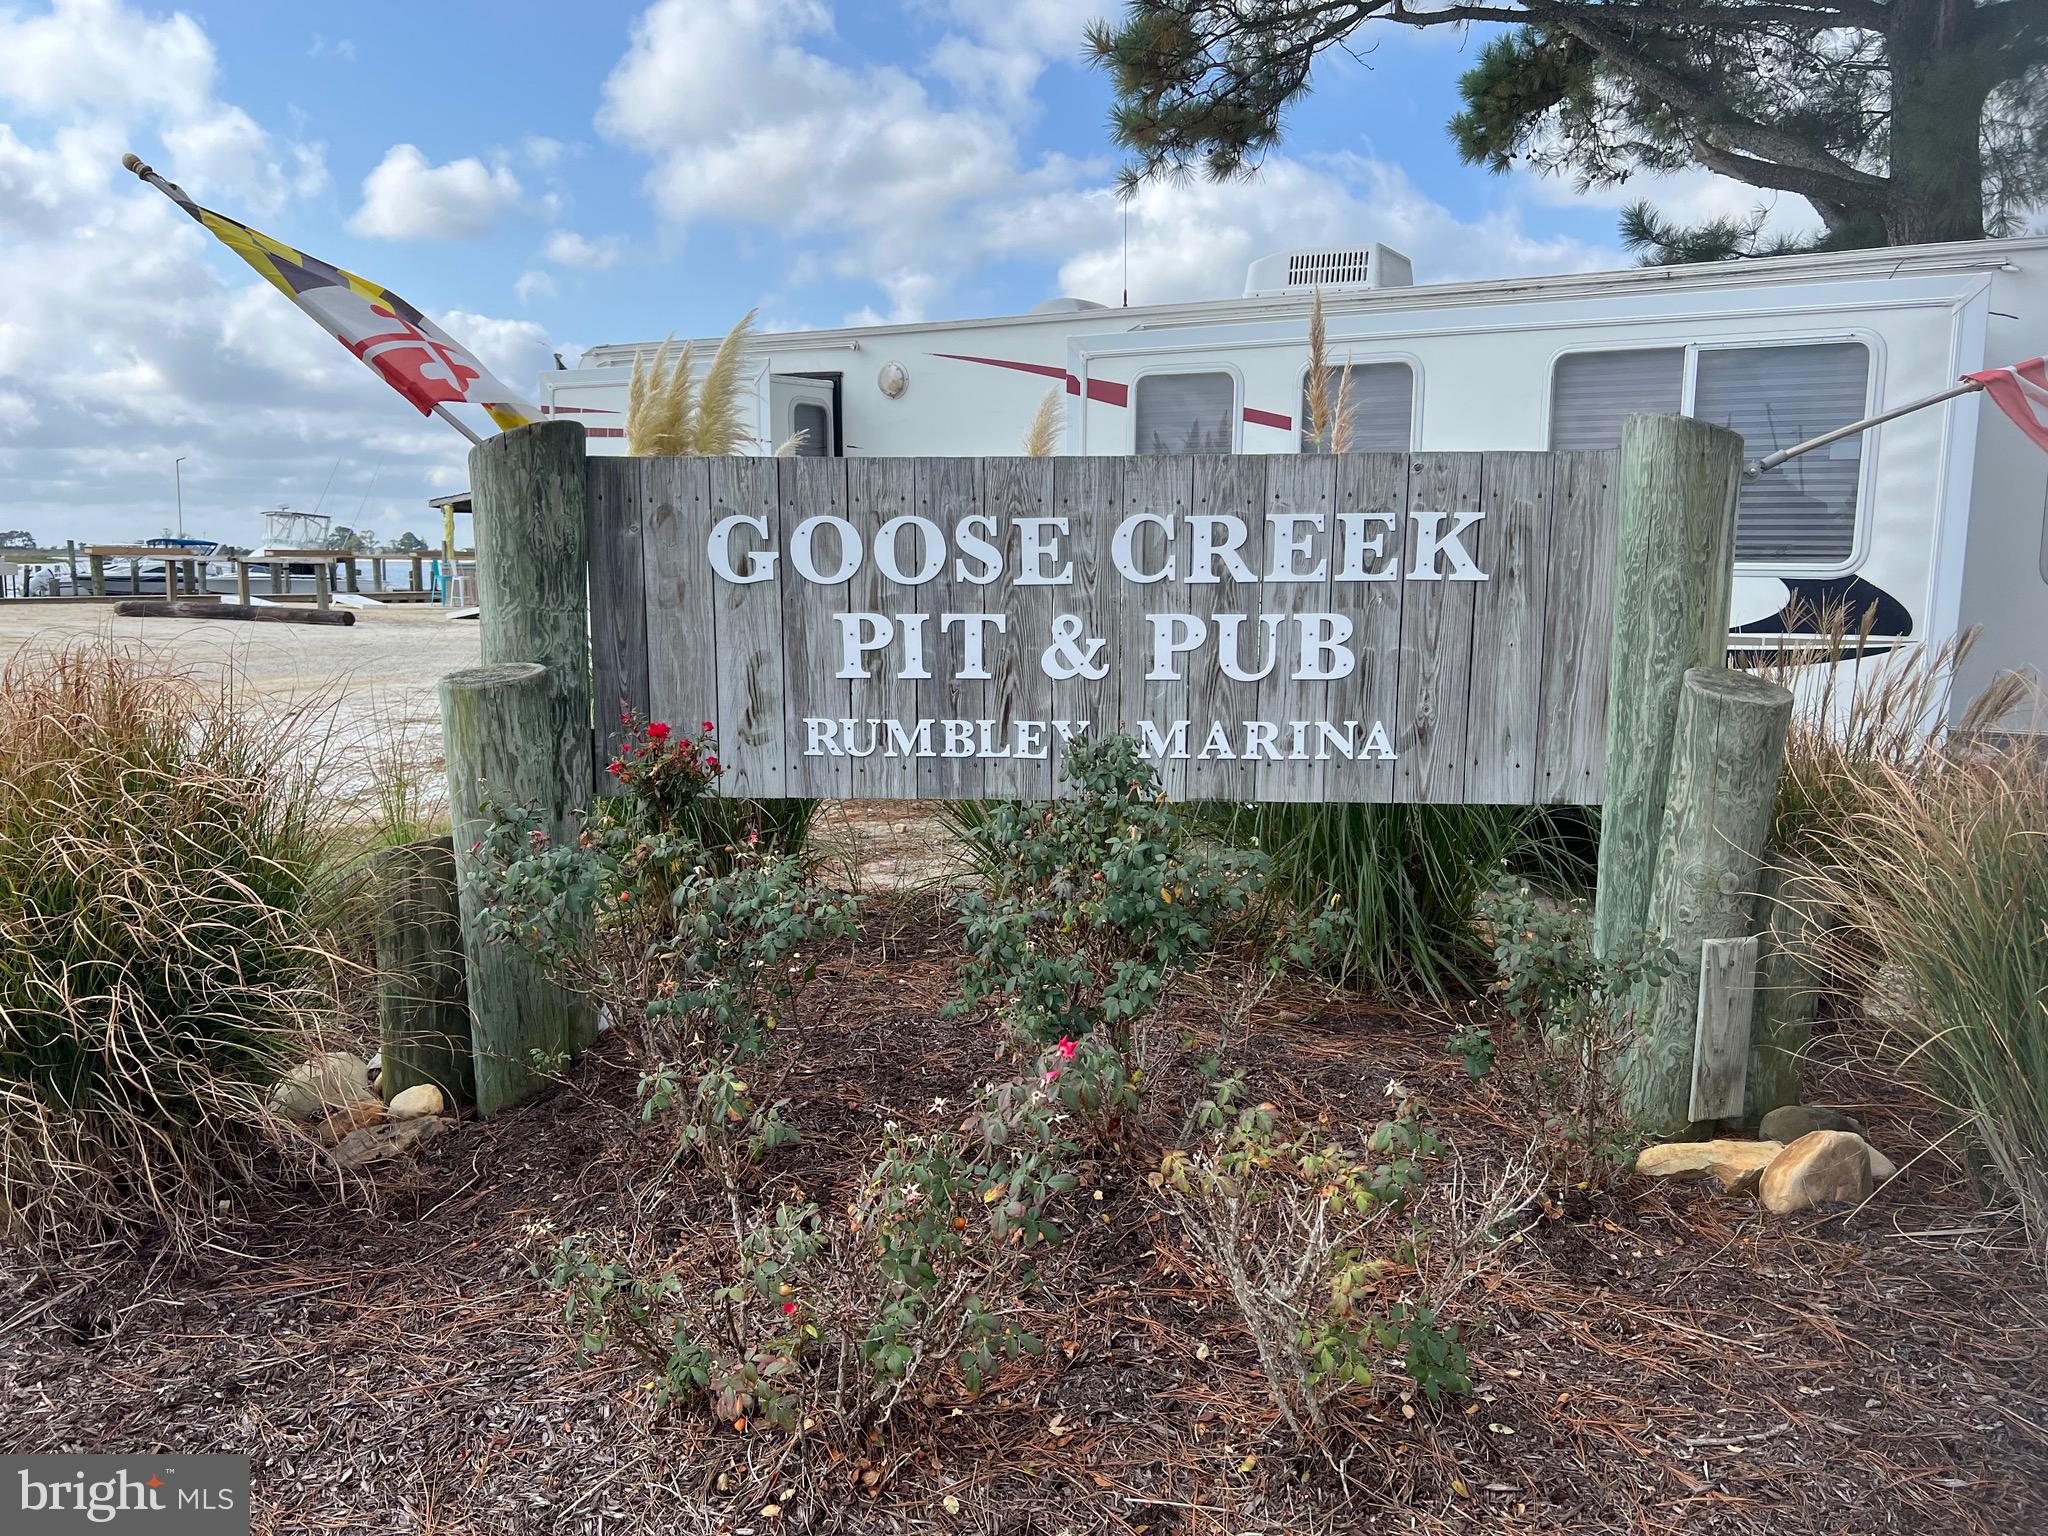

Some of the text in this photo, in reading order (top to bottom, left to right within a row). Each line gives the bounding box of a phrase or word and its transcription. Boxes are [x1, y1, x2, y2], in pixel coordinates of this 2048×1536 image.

[707, 511, 1490, 586] GOOSE CREEK
[833, 612, 1356, 682] PIT & PUB
[1137, 720, 1399, 761] MARINA
